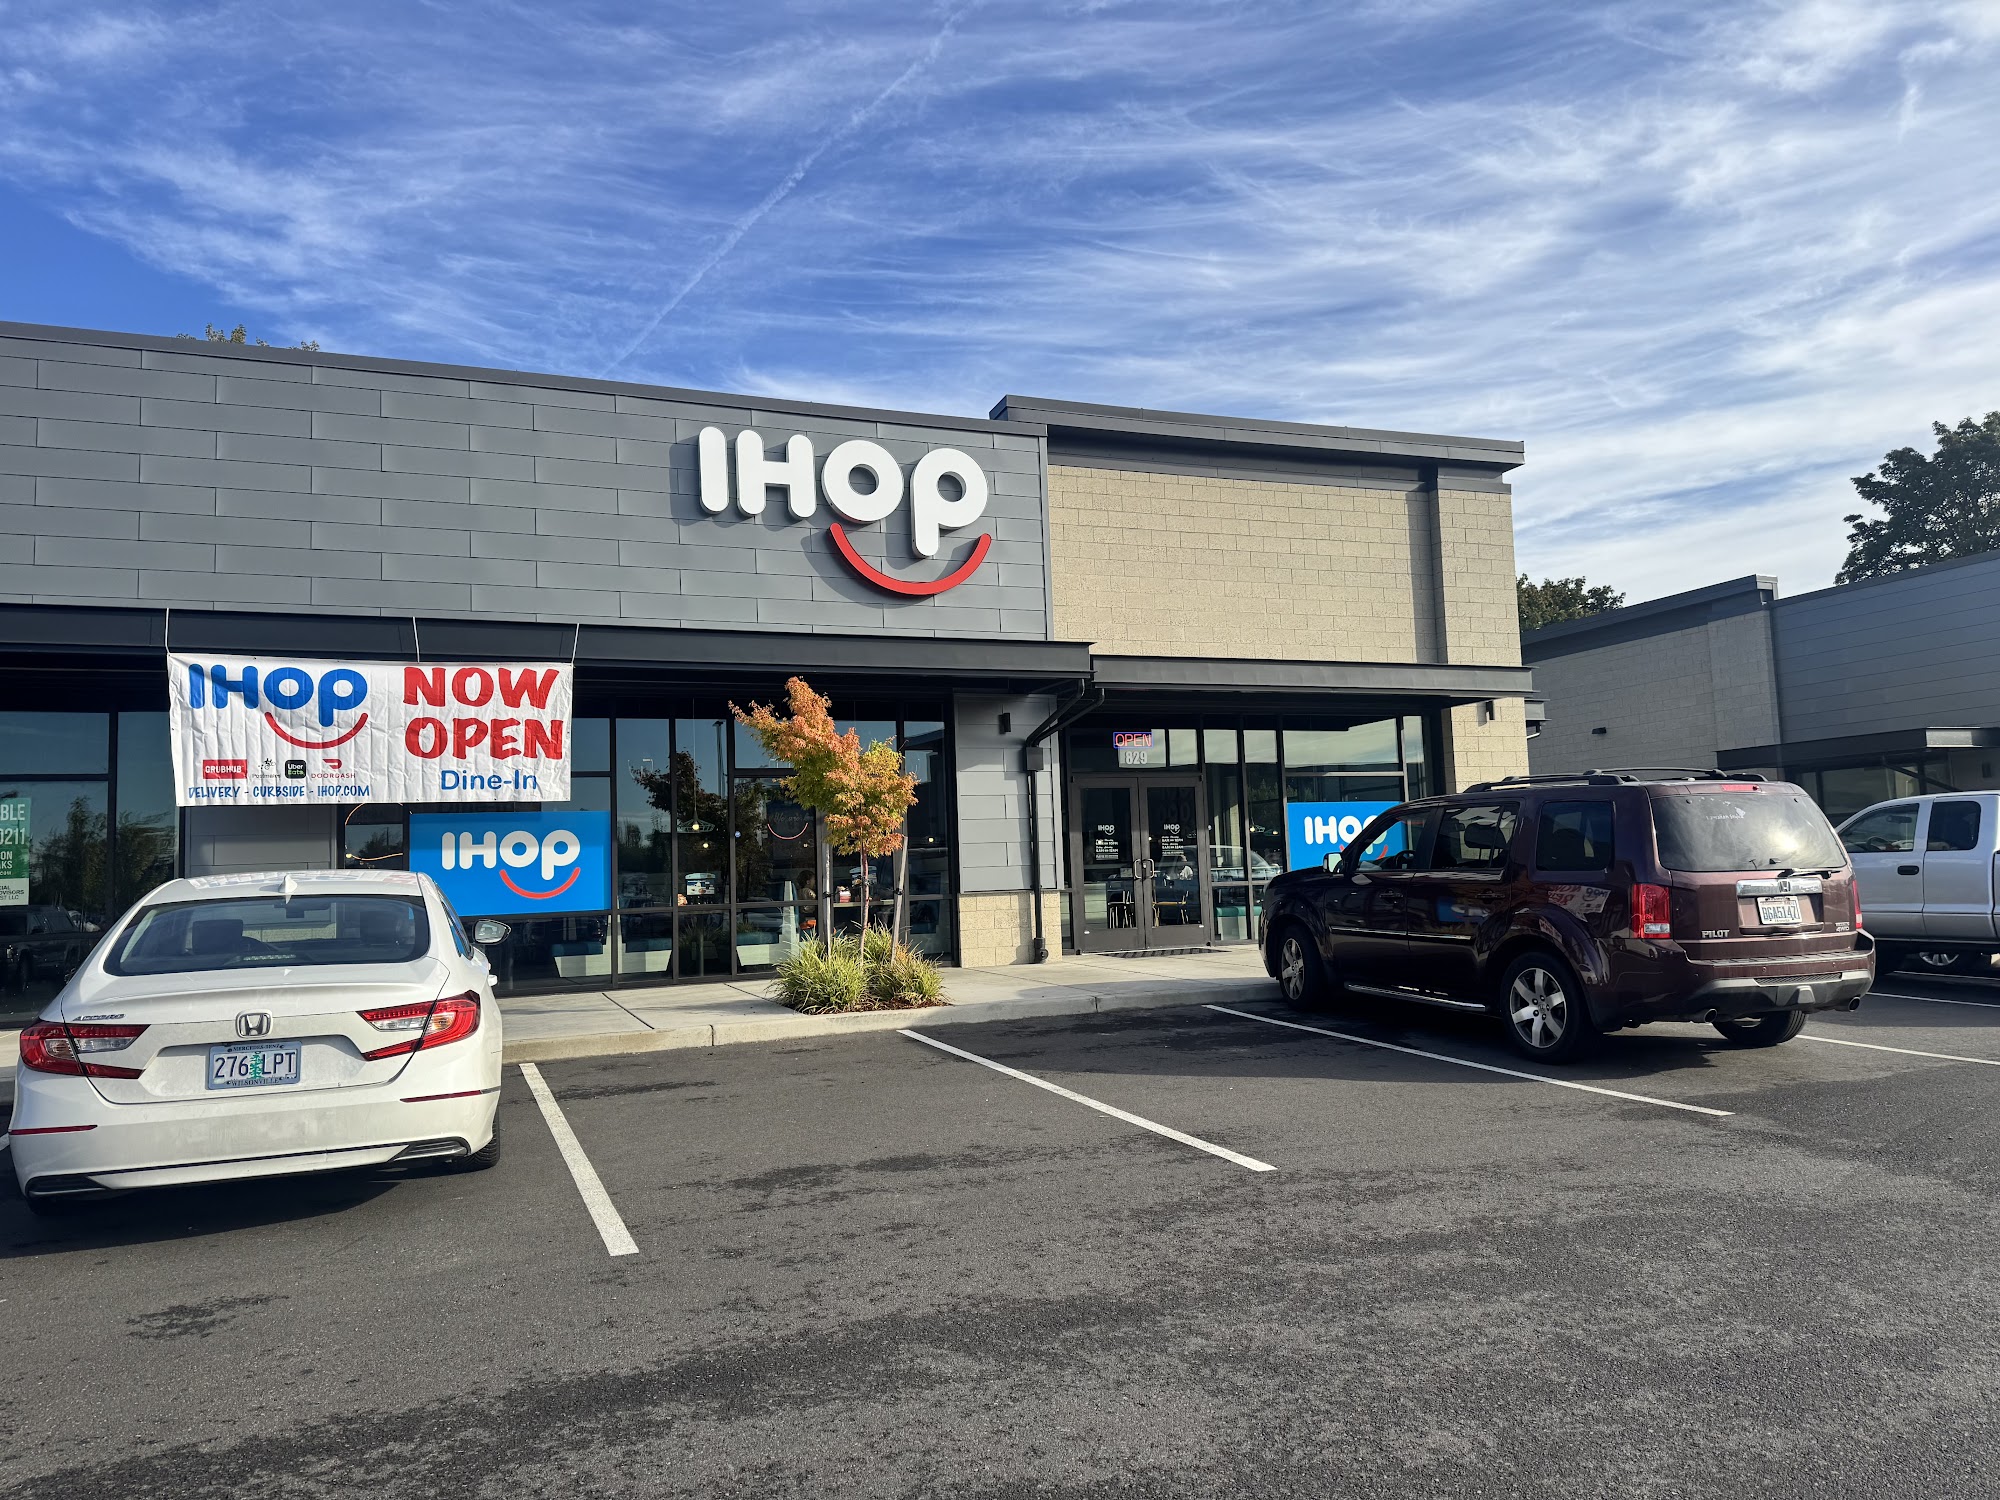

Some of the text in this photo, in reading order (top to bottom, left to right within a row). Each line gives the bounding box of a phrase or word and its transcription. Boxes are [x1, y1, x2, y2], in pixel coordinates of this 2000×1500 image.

[698, 426, 990, 557] IHOP
[188, 663, 368, 727] IHOP
[403, 667, 560, 709] NOW
[405, 717, 564, 760] OPEN
[1115, 733, 1152, 747] OPEN
[1125, 750, 1148, 765] 829
[205, 765, 243, 774] GRUBHUB
[440, 769, 538, 791] Dine-In
[188, 786, 241, 798] DELIVERY
[253, 785, 305, 798] CURBSIDE
[317, 785, 370, 797] IHOP.COM
[0, 804, 25, 820] BLE
[1097, 824, 1115, 833] IHOP
[1163, 823, 1180, 832] IHOP
[441, 829, 581, 881] IHOP
[0, 861, 13, 869] KS
[1701, 929, 1730, 939] PILOT
[214, 1051, 296, 1078] 276 LPT
[231, 1077, 280, 1086] WILSONVILLE
